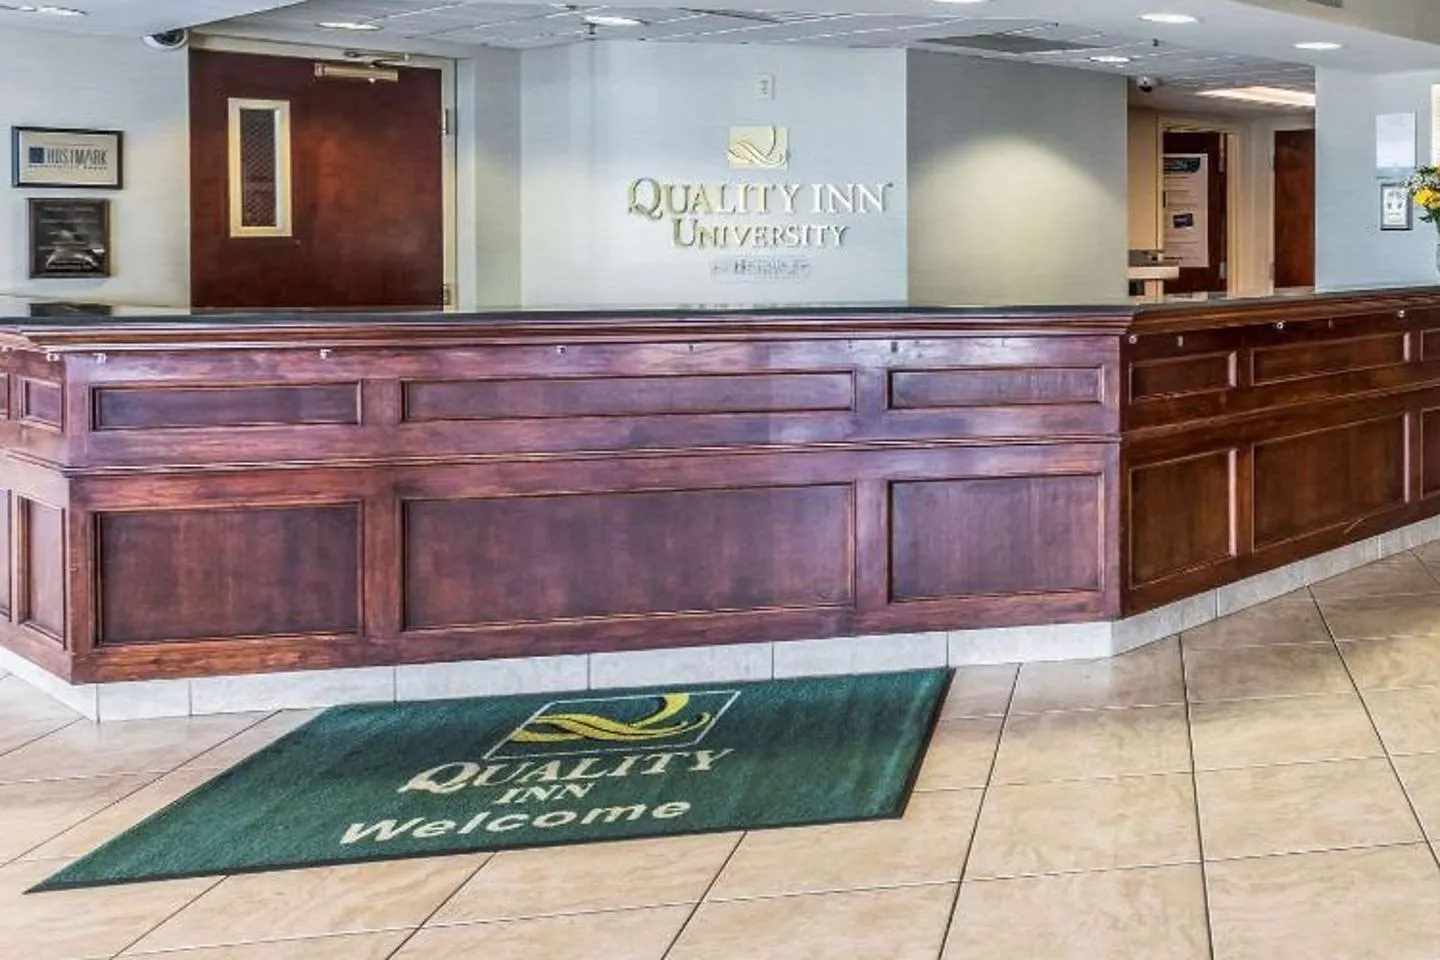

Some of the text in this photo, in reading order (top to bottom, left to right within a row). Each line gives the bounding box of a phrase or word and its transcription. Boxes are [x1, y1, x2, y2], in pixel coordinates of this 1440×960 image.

[628, 177, 888, 220] QUALITY INN
[672, 218, 850, 247] UNIVERSITY
[397, 748, 735, 794] QUALITY
[492, 782, 600, 805] INN
[339, 800, 692, 845] Welcome
